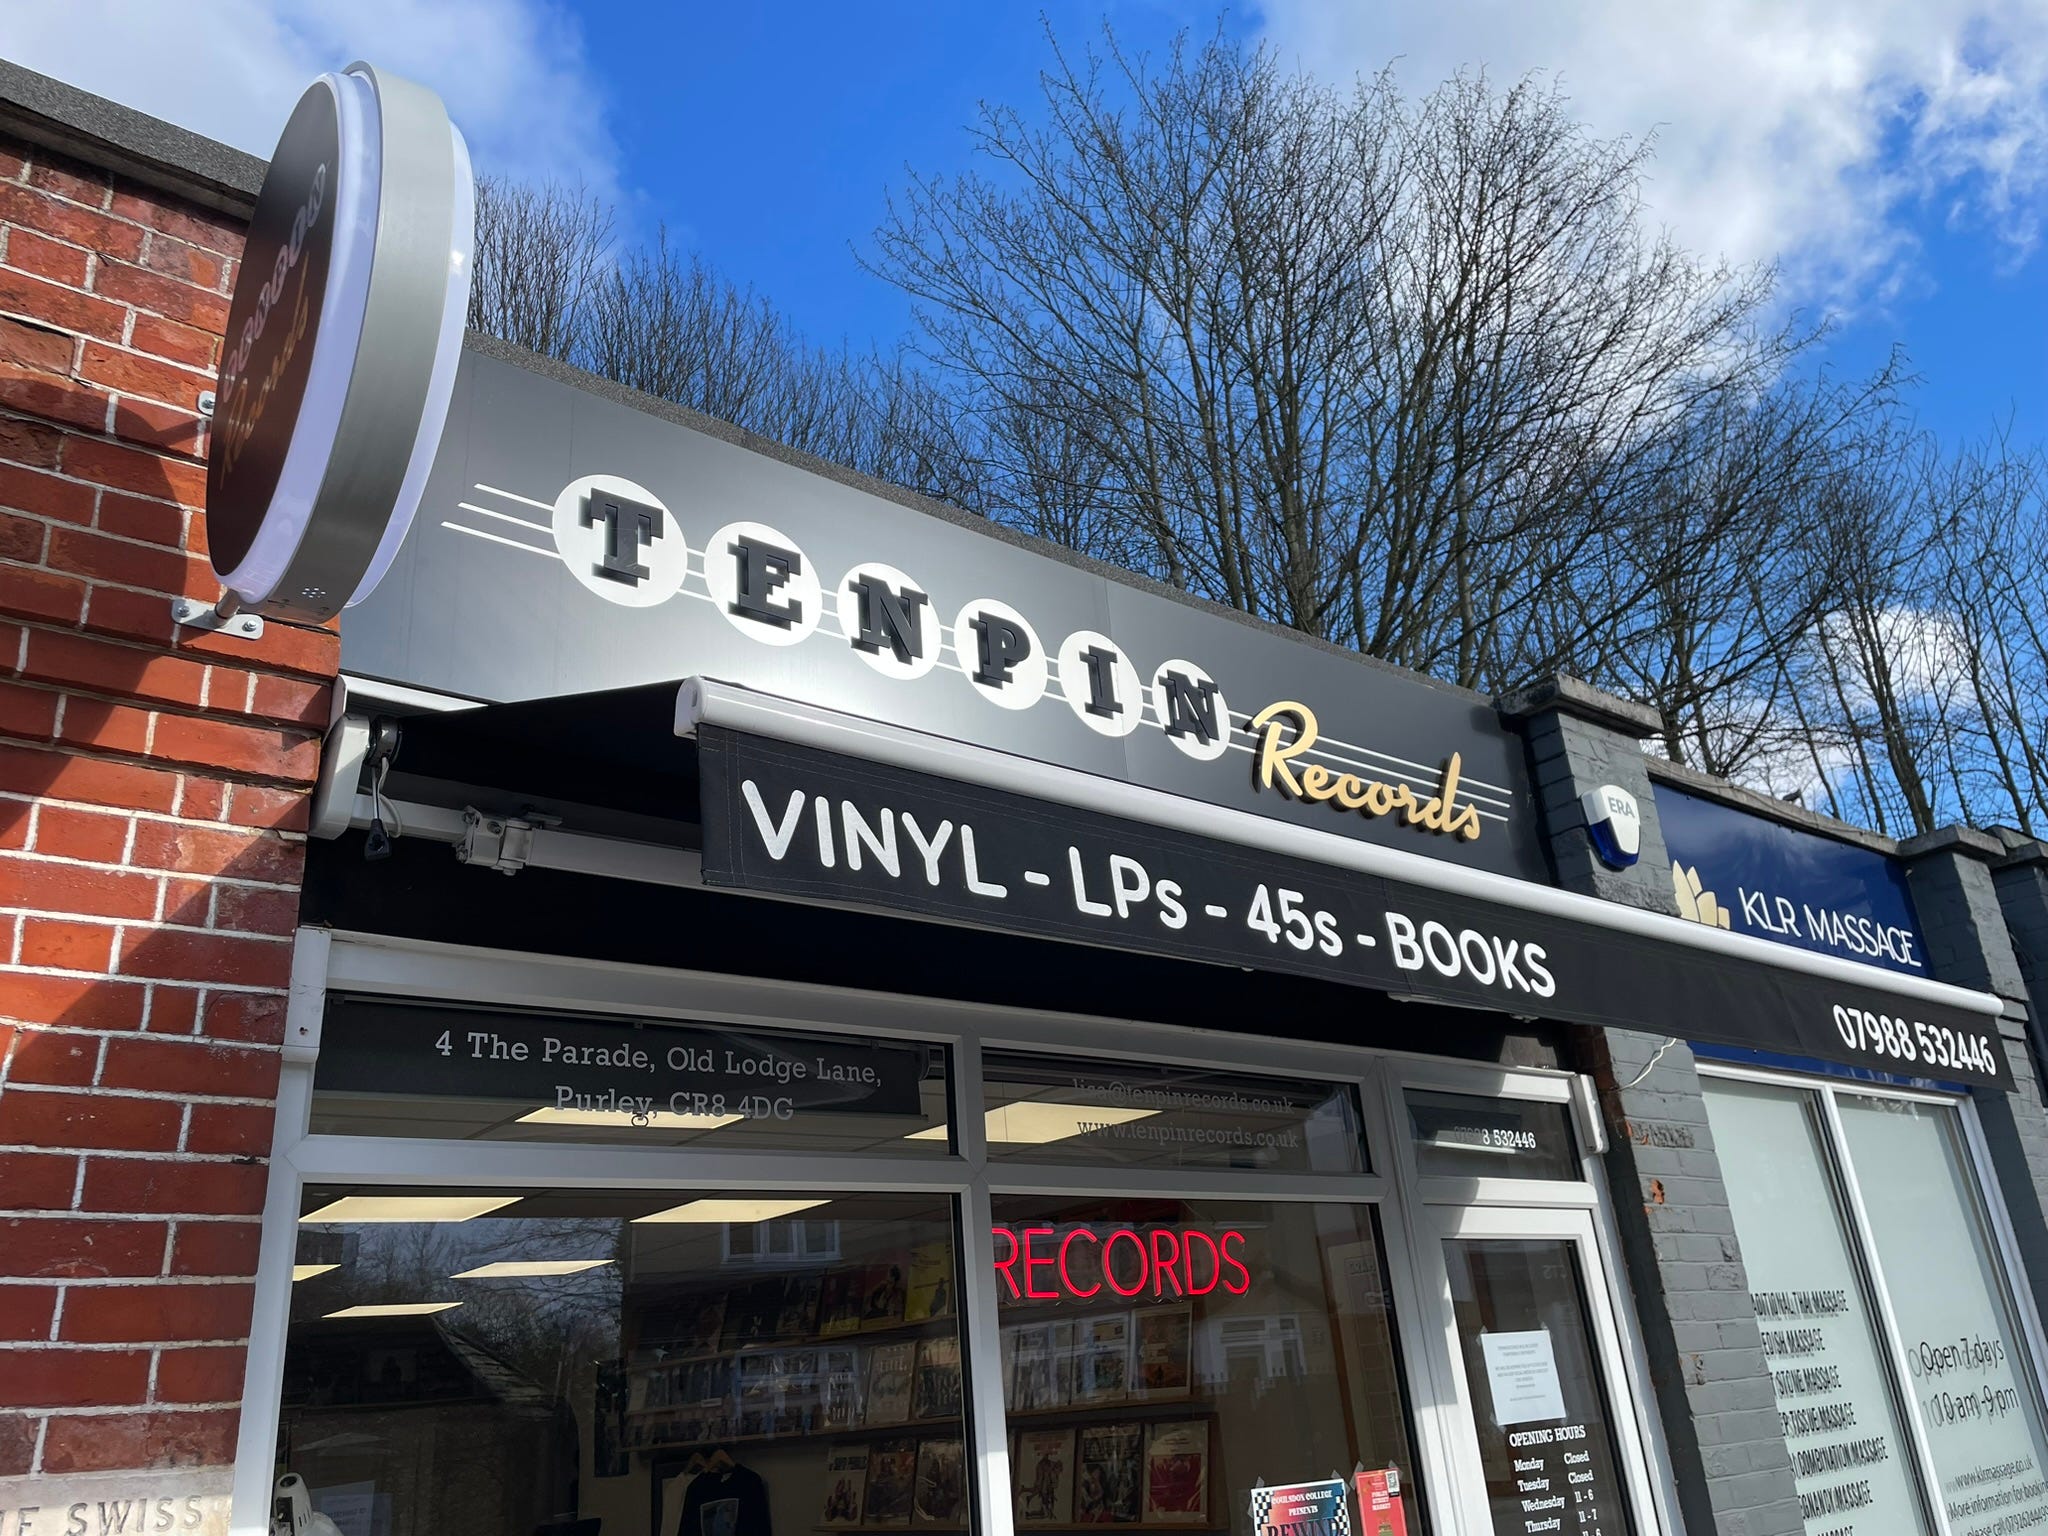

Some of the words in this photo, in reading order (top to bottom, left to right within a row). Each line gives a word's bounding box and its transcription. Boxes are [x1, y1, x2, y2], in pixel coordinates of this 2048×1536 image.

[579, 488, 1219, 747] TENPIN
[1249, 701, 1481, 841] Records
[1608, 796, 1637, 820] ERA
[741, 780, 1008, 898] VINYL
[1068, 846, 1188, 930] LPs
[1247, 883, 1344, 958] 45s
[1384, 911, 1556, 998] BOOKS
[1737, 886, 1802, 938] KLR
[1803, 903, 1922, 968] MASSAGE
[1832, 1003, 1917, 1063] 07988
[1914, 1021, 1997, 1077] 532446
[434, 1030, 453, 1057] 4
[467, 1032, 530, 1063] The
[542, 1037, 656, 1074] Parade,
[667, 1046, 715, 1074] Old
[724, 1050, 807, 1085] Lodge
[816, 1057, 882, 1087] Lane,
[555, 1085, 658, 1121] Purley,
[669, 1091, 726, 1118] CR8
[738, 1095, 794, 1121] 4DG
[1076, 1119, 1300, 1149] www.tenpinrecords.co.uk
[1493, 1129, 1537, 1149] 532446
[991, 1227, 1250, 1299] RECORDS
[1786, 1328, 1826, 1354] MASSAGE
[1919, 1341, 1963, 1377] Open
[1960, 1337, 1971, 1366] 7
[1973, 1333, 2005, 1368] days
[1803, 1365, 1842, 1392] MASSAGE
[1818, 1402, 1857, 1430] MASSAGE
[1509, 1428, 1553, 1447] OPENING
[1555, 1425, 1586, 1440] HOURS
[1850, 1436, 1889, 1464] MASSAGE
[1514, 1457, 1544, 1472] Monday
[1564, 1450, 1590, 1464] Closed
[1517, 1476, 1550, 1492] Tuesday
[1568, 1469, 1594, 1484] Closed
[1521, 1495, 1565, 1512] Wednesday
[1588, 1489, 1594, 1501] 6
[1834, 1479, 1874, 1512] MASSAGE
[65, 1494, 203, 1536] SWISS
[1525, 1516, 1561, 1534] Thursday
[1592, 1508, 1598, 1521] 7
[1948, 1501, 1972, 1520] More
